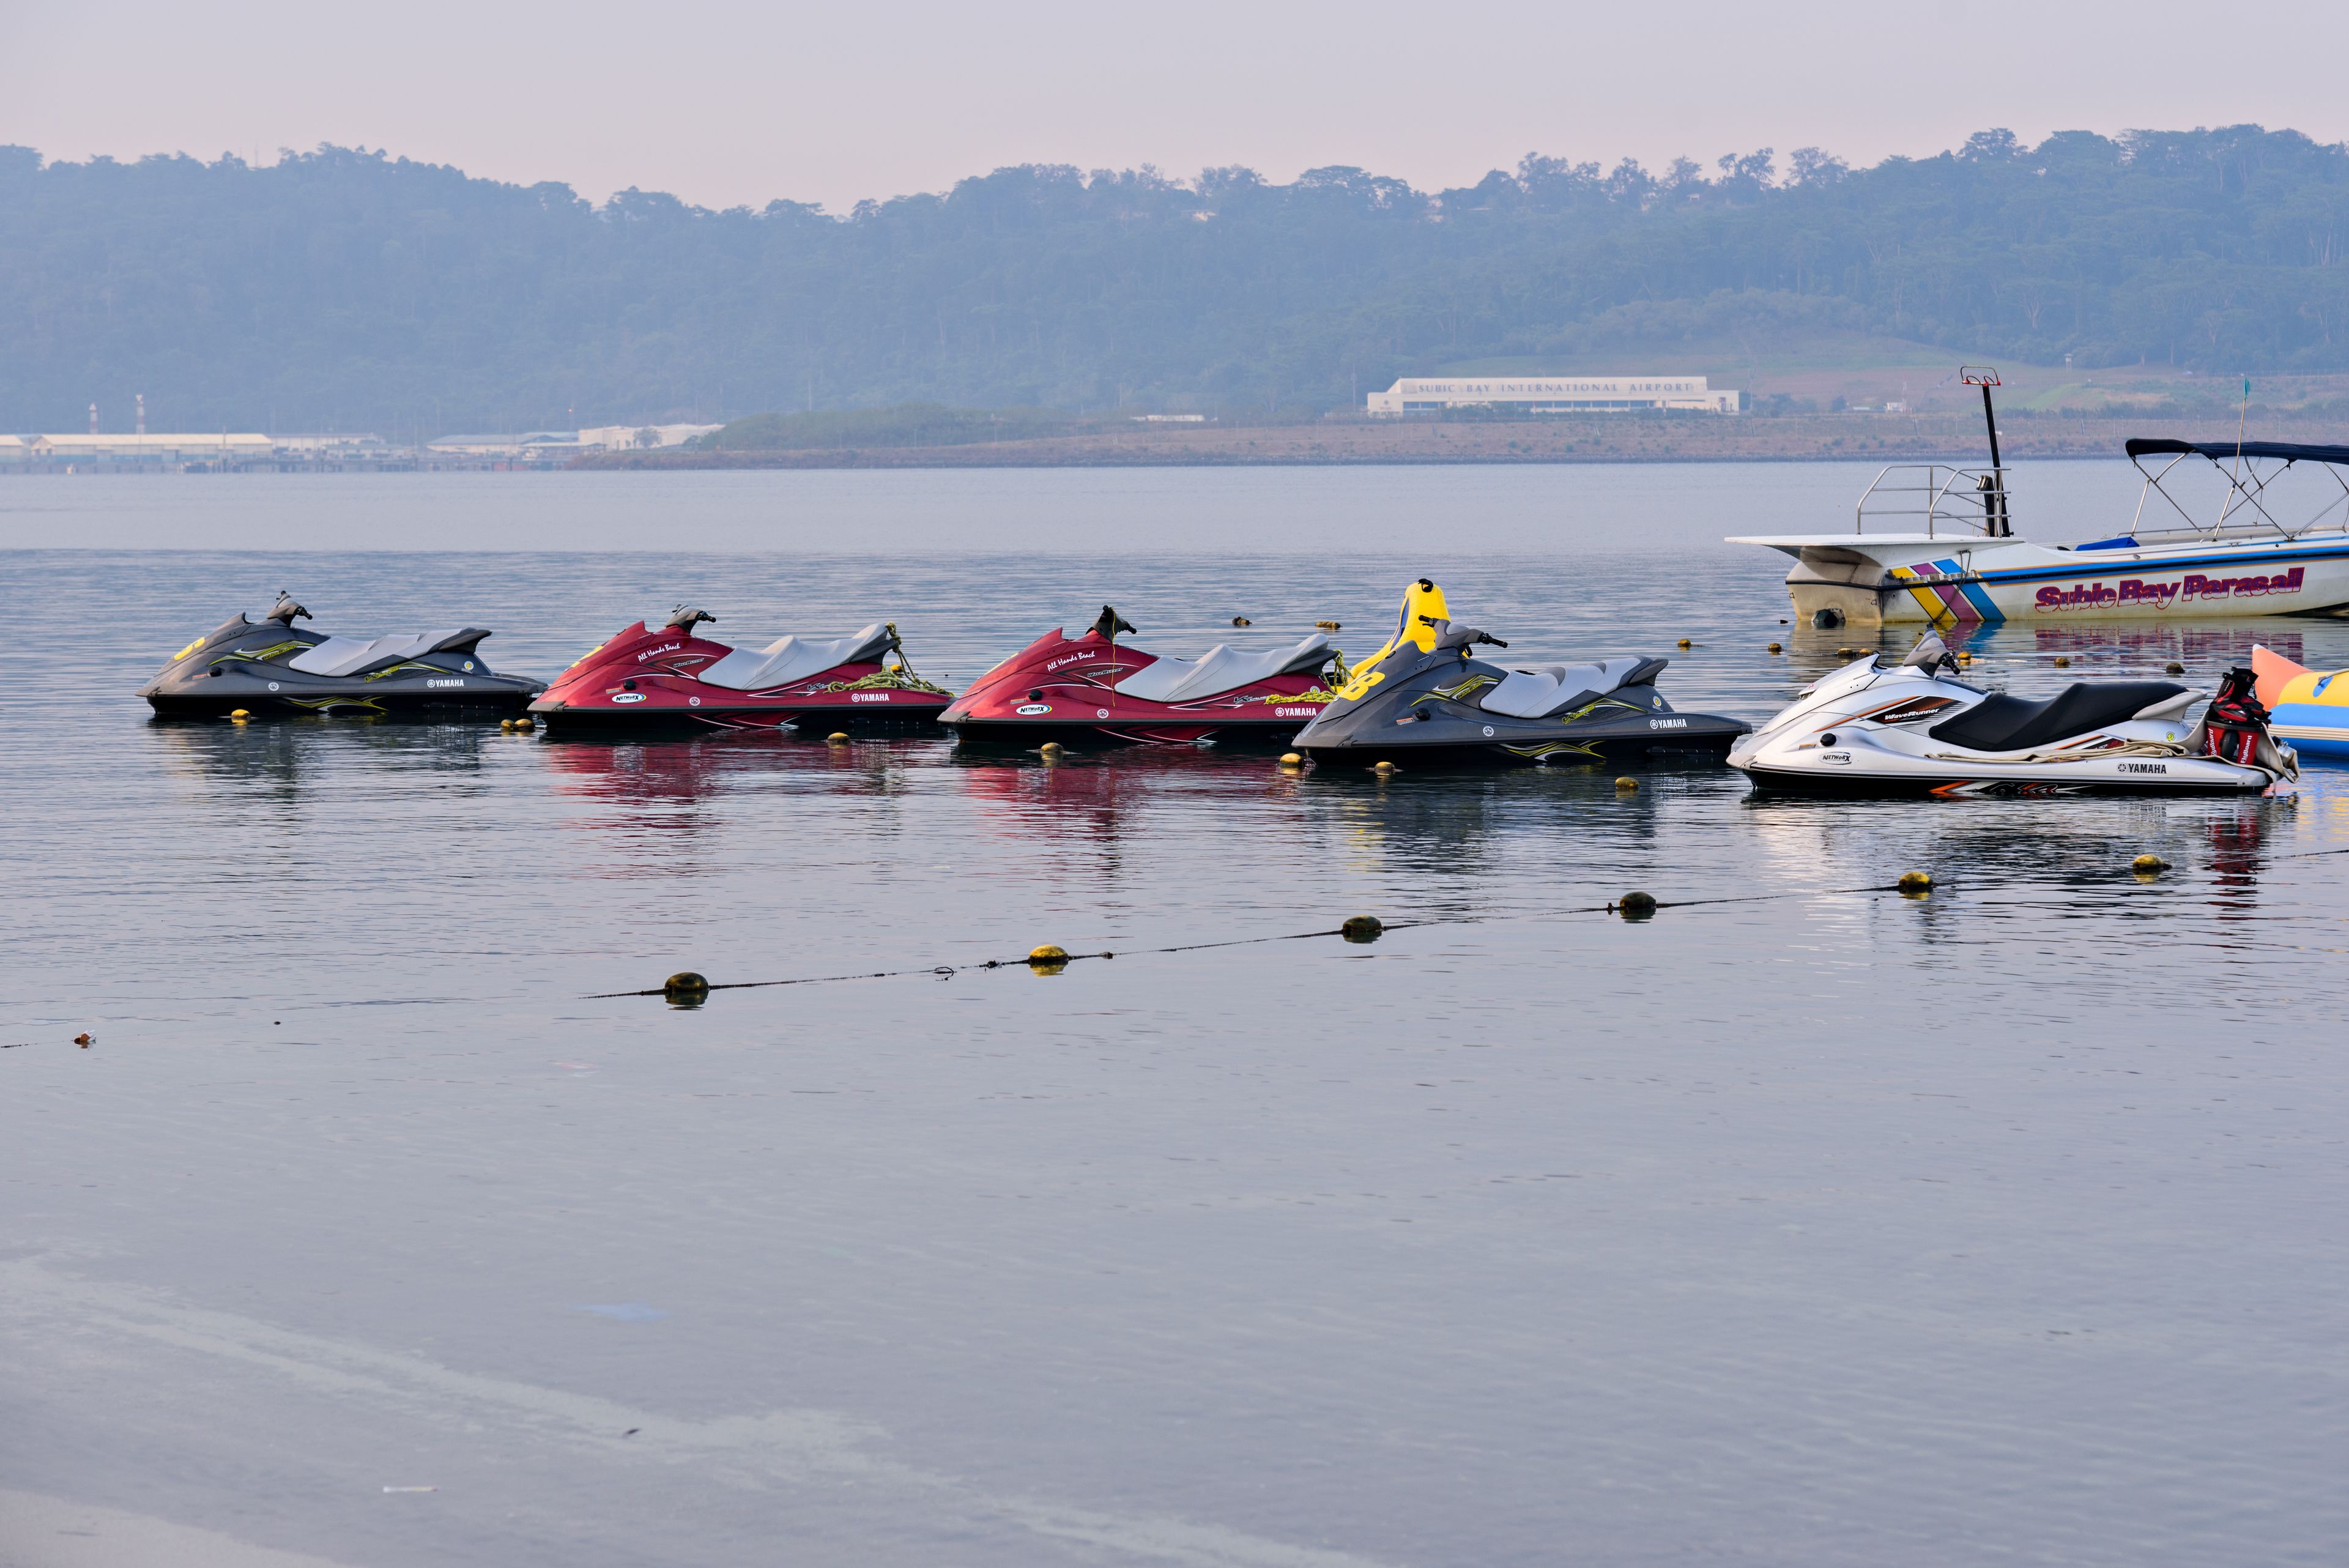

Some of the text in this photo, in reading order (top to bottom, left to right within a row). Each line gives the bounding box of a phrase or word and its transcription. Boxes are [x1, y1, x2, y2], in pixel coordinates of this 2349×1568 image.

[1501, 384, 1617, 392] INTERNATIONAL
[1630, 383, 1691, 392] AIRPORT
[2035, 567, 2305, 613] Subic Bay Parasail
[637, 642, 680, 663] All Hands Beach
[1047, 651, 1095, 672] All Hands Beach
[1658, 719, 1687, 728] YAMAHA
[1885, 708, 1939, 720] WaveRunner
[2208, 728, 2217, 756] lyBoard
[2240, 735, 2252, 764] FlyBoard
[2129, 764, 2166, 773] YAMAHA
